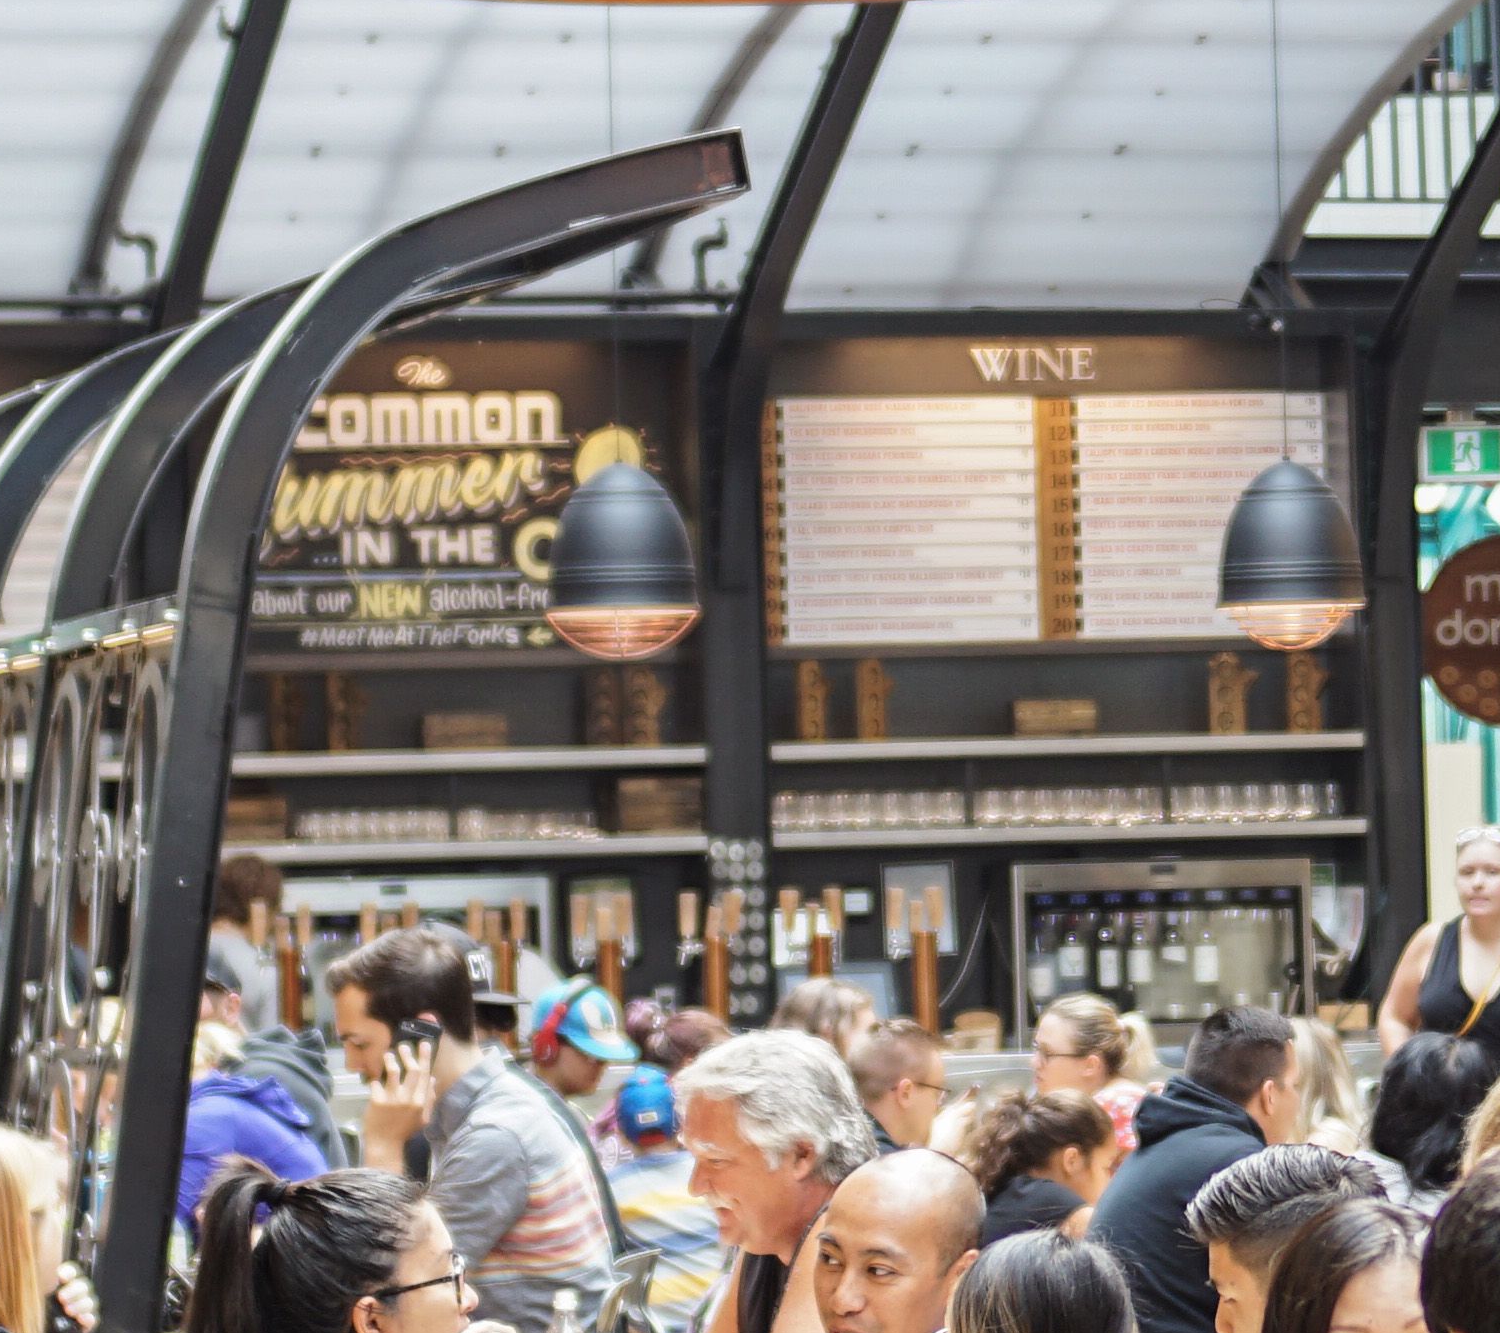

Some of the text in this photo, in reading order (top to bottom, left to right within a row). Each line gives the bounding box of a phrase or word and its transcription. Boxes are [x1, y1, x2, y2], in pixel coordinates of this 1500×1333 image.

[396, 359, 447, 387] The
[969, 347, 1096, 382] WINE
[1050, 401, 1069, 417] 11
[1049, 425, 1069, 441] 12
[1050, 449, 1069, 465] 13
[1051, 473, 1069, 489] 14
[270, 451, 546, 533] ummer
[1051, 497, 1069, 514] 15
[1052, 521, 1070, 537] 16
[410, 527, 497, 564] THE
[1053, 545, 1070, 562] 17
[1053, 569, 1071, 585] 18
[251, 586, 309, 616] about
[315, 591, 351, 613] our
[358, 583, 423, 617] NEW
[1053, 594, 1071, 610] 19
[1052, 617, 1072, 634] 20
